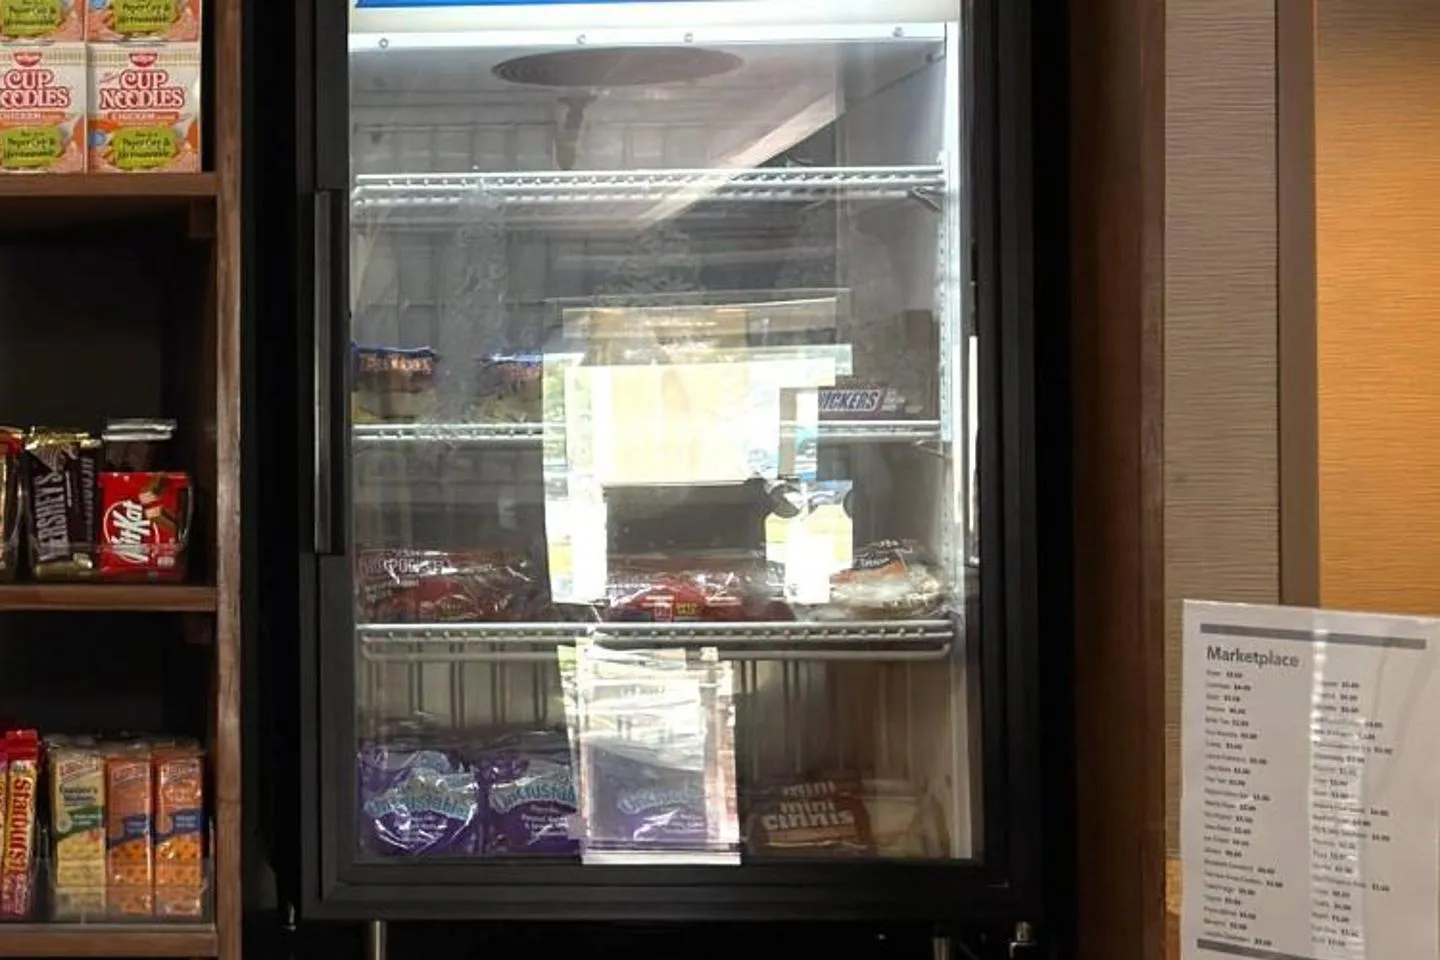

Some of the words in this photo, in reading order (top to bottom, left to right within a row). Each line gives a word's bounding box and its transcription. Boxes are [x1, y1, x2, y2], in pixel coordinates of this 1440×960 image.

[4, 69, 54, 89] CUP
[119, 69, 169, 89] CUP
[100, 87, 185, 109] NOODLES
[1206, 646, 1300, 669] Marketplace
[780, 799, 839, 815] mini
